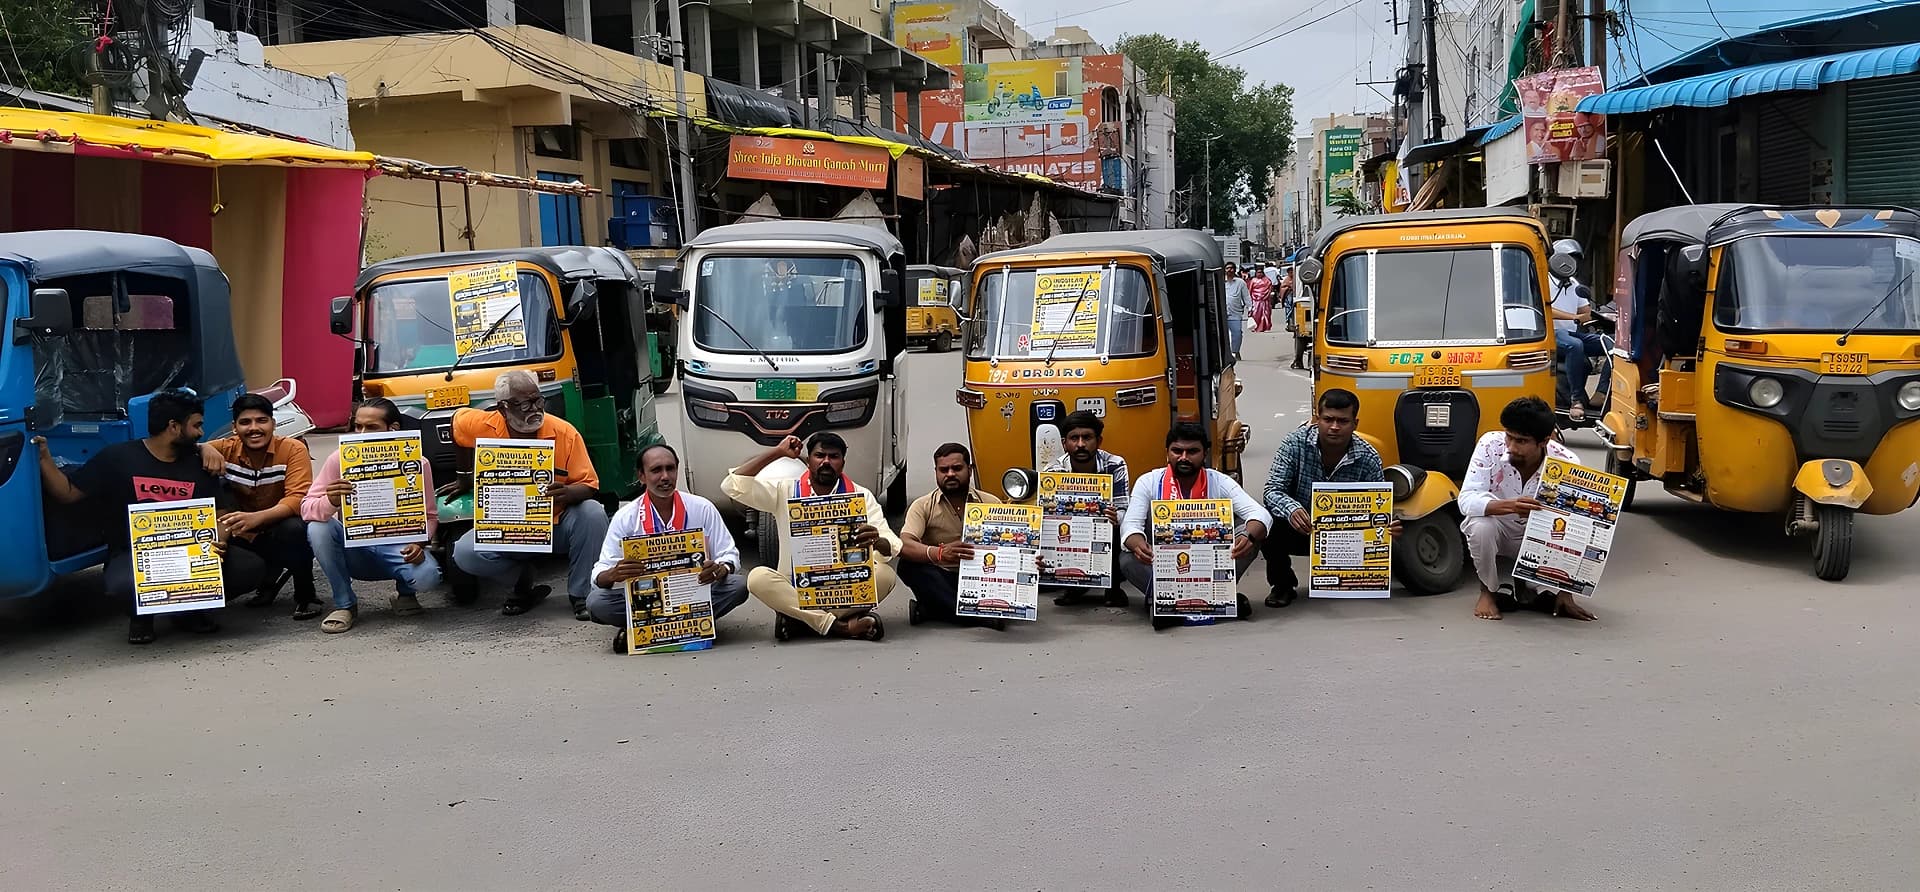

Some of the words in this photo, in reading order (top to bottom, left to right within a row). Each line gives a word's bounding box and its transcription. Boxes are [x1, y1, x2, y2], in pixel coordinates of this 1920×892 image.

[733, 150, 757, 164] Shree
[784, 154, 821, 168] Bhavani
[824, 157, 856, 170] Ganesh
[1389, 353, 1424, 364] FOR
[765, 410, 790, 419] TVS
[362, 445, 400, 453] INQUILAB
[497, 452, 533, 460] INQUILAB
[1568, 467, 1611, 485] INQUILAB
[1176, 503, 1216, 511] INQUILAB
[153, 513, 193, 523] INQUILAB
[803, 509, 851, 519] INQUILAB
[646, 535, 687, 547] INQUILAB
[815, 596, 855, 605] INQUILAB
[651, 618, 699, 634] INQUILAB
